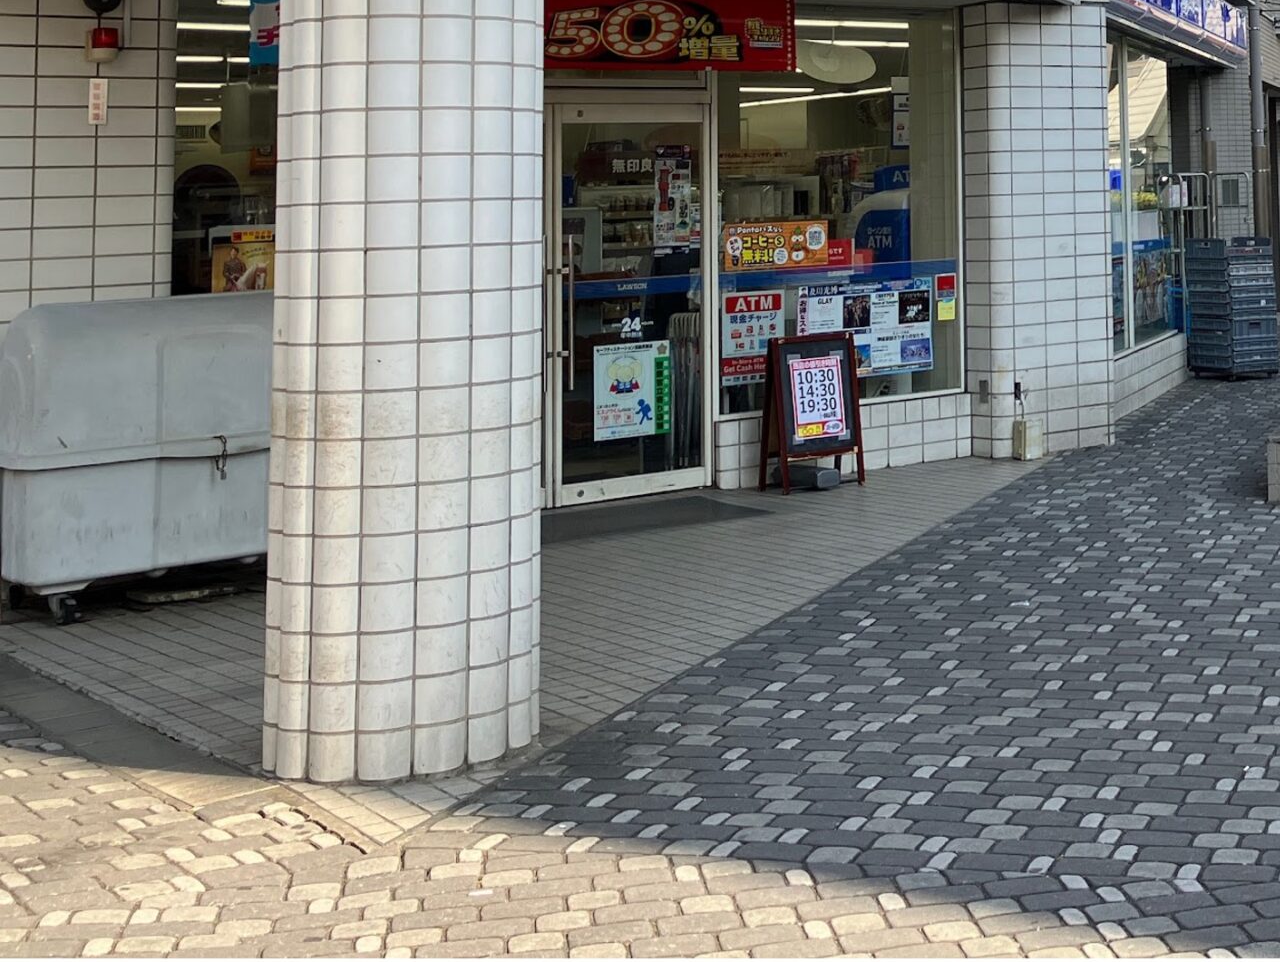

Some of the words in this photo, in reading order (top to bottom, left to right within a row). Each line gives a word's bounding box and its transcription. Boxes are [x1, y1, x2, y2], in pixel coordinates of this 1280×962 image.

[679, 35, 740, 61] 増量
[612, 159, 653, 174] 無印良
[867, 235, 892, 249] ATM
[735, 295, 773, 312] ATM
[817, 297, 833, 305] GLAY
[621, 317, 642, 332] 24
[730, 312, 777, 324] 現金チャージ
[797, 369, 835, 385] 10:30
[799, 383, 836, 399] 14:30
[800, 397, 837, 413] 19:30
